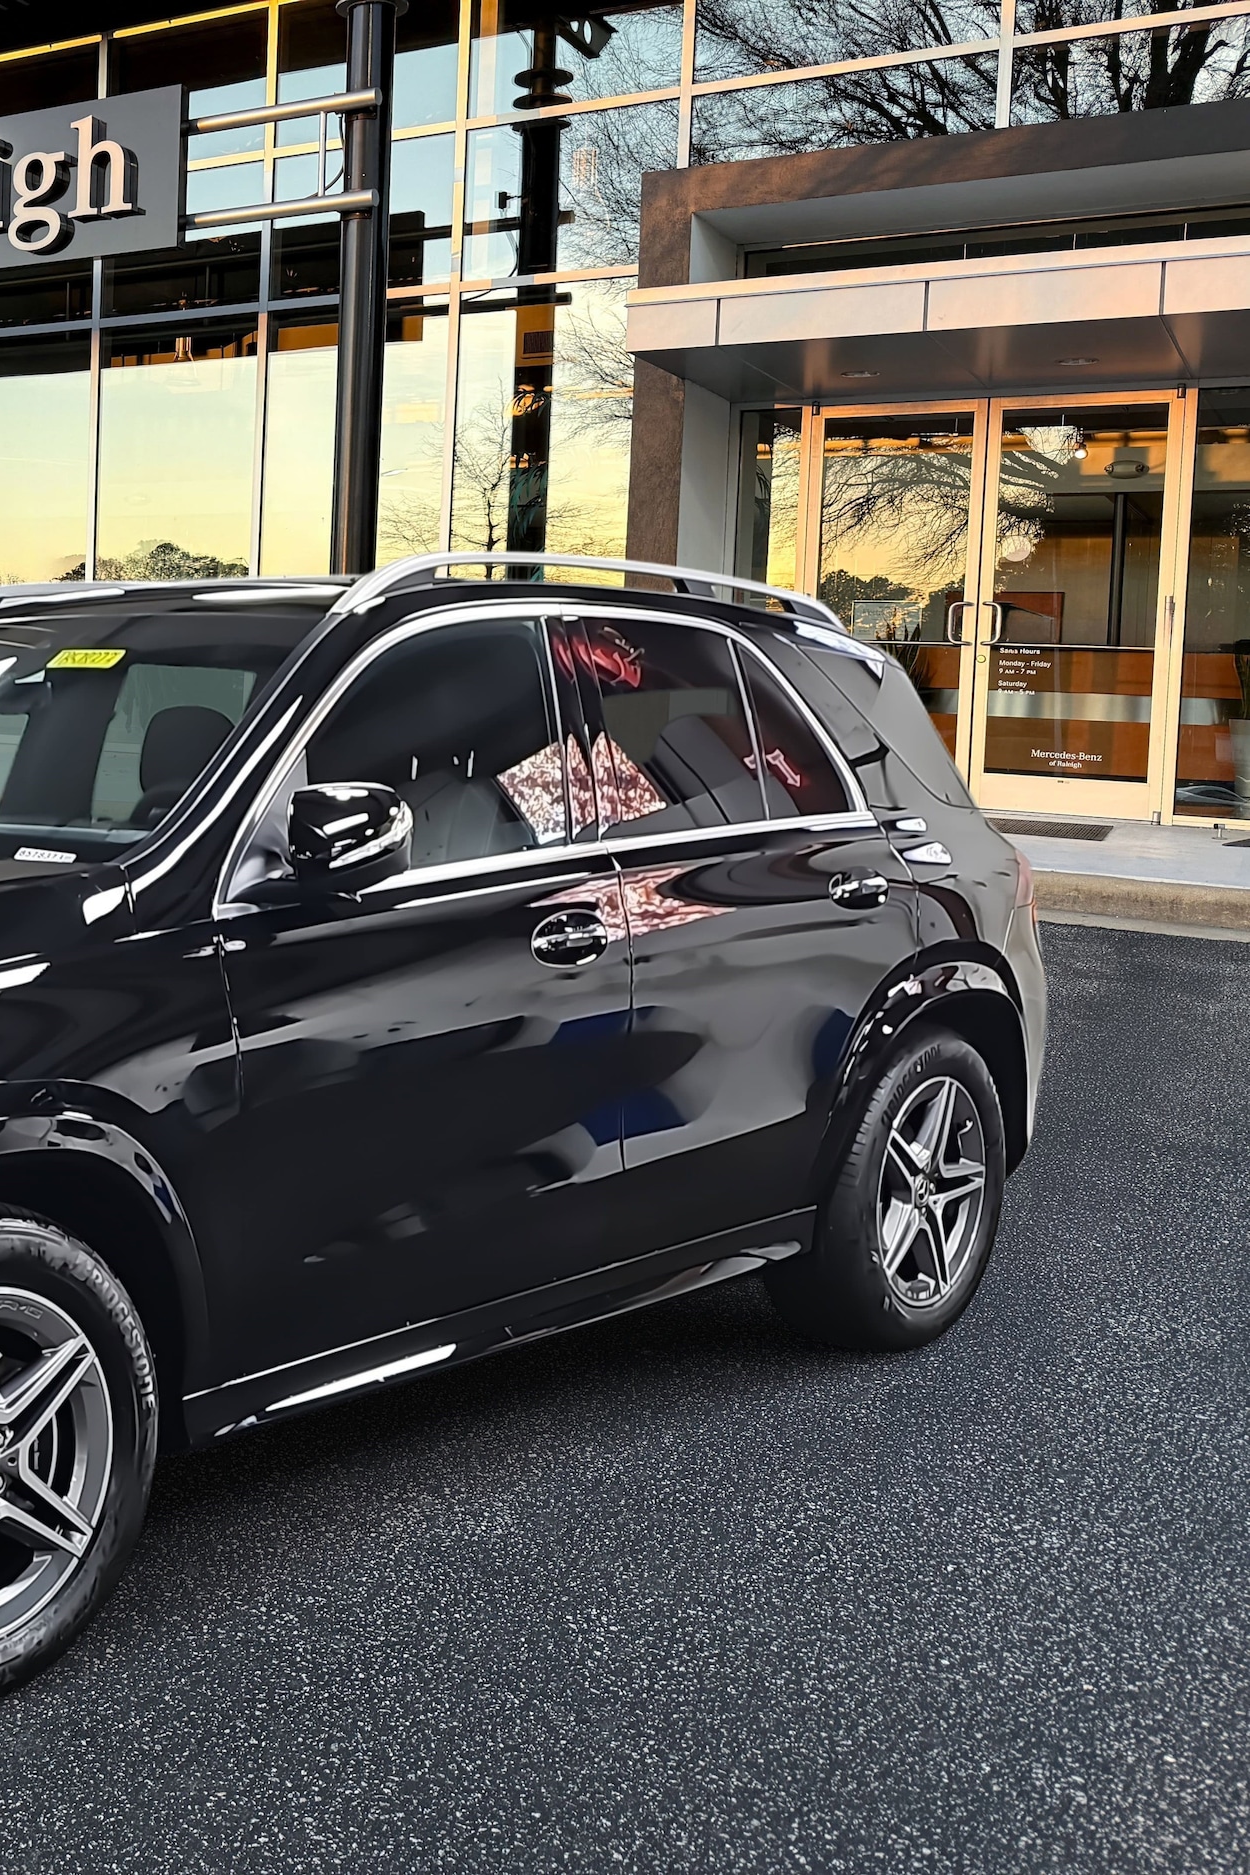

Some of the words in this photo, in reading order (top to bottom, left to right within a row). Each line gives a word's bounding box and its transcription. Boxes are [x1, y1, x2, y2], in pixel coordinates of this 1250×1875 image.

[999, 660, 1025, 668] Monday
[1031, 660, 1052, 668] Friday
[998, 680, 1028, 688] Saturday
[1031, 749, 1102, 761] Mercedes-Benz
[1057, 761, 1082, 769] Raleigh
